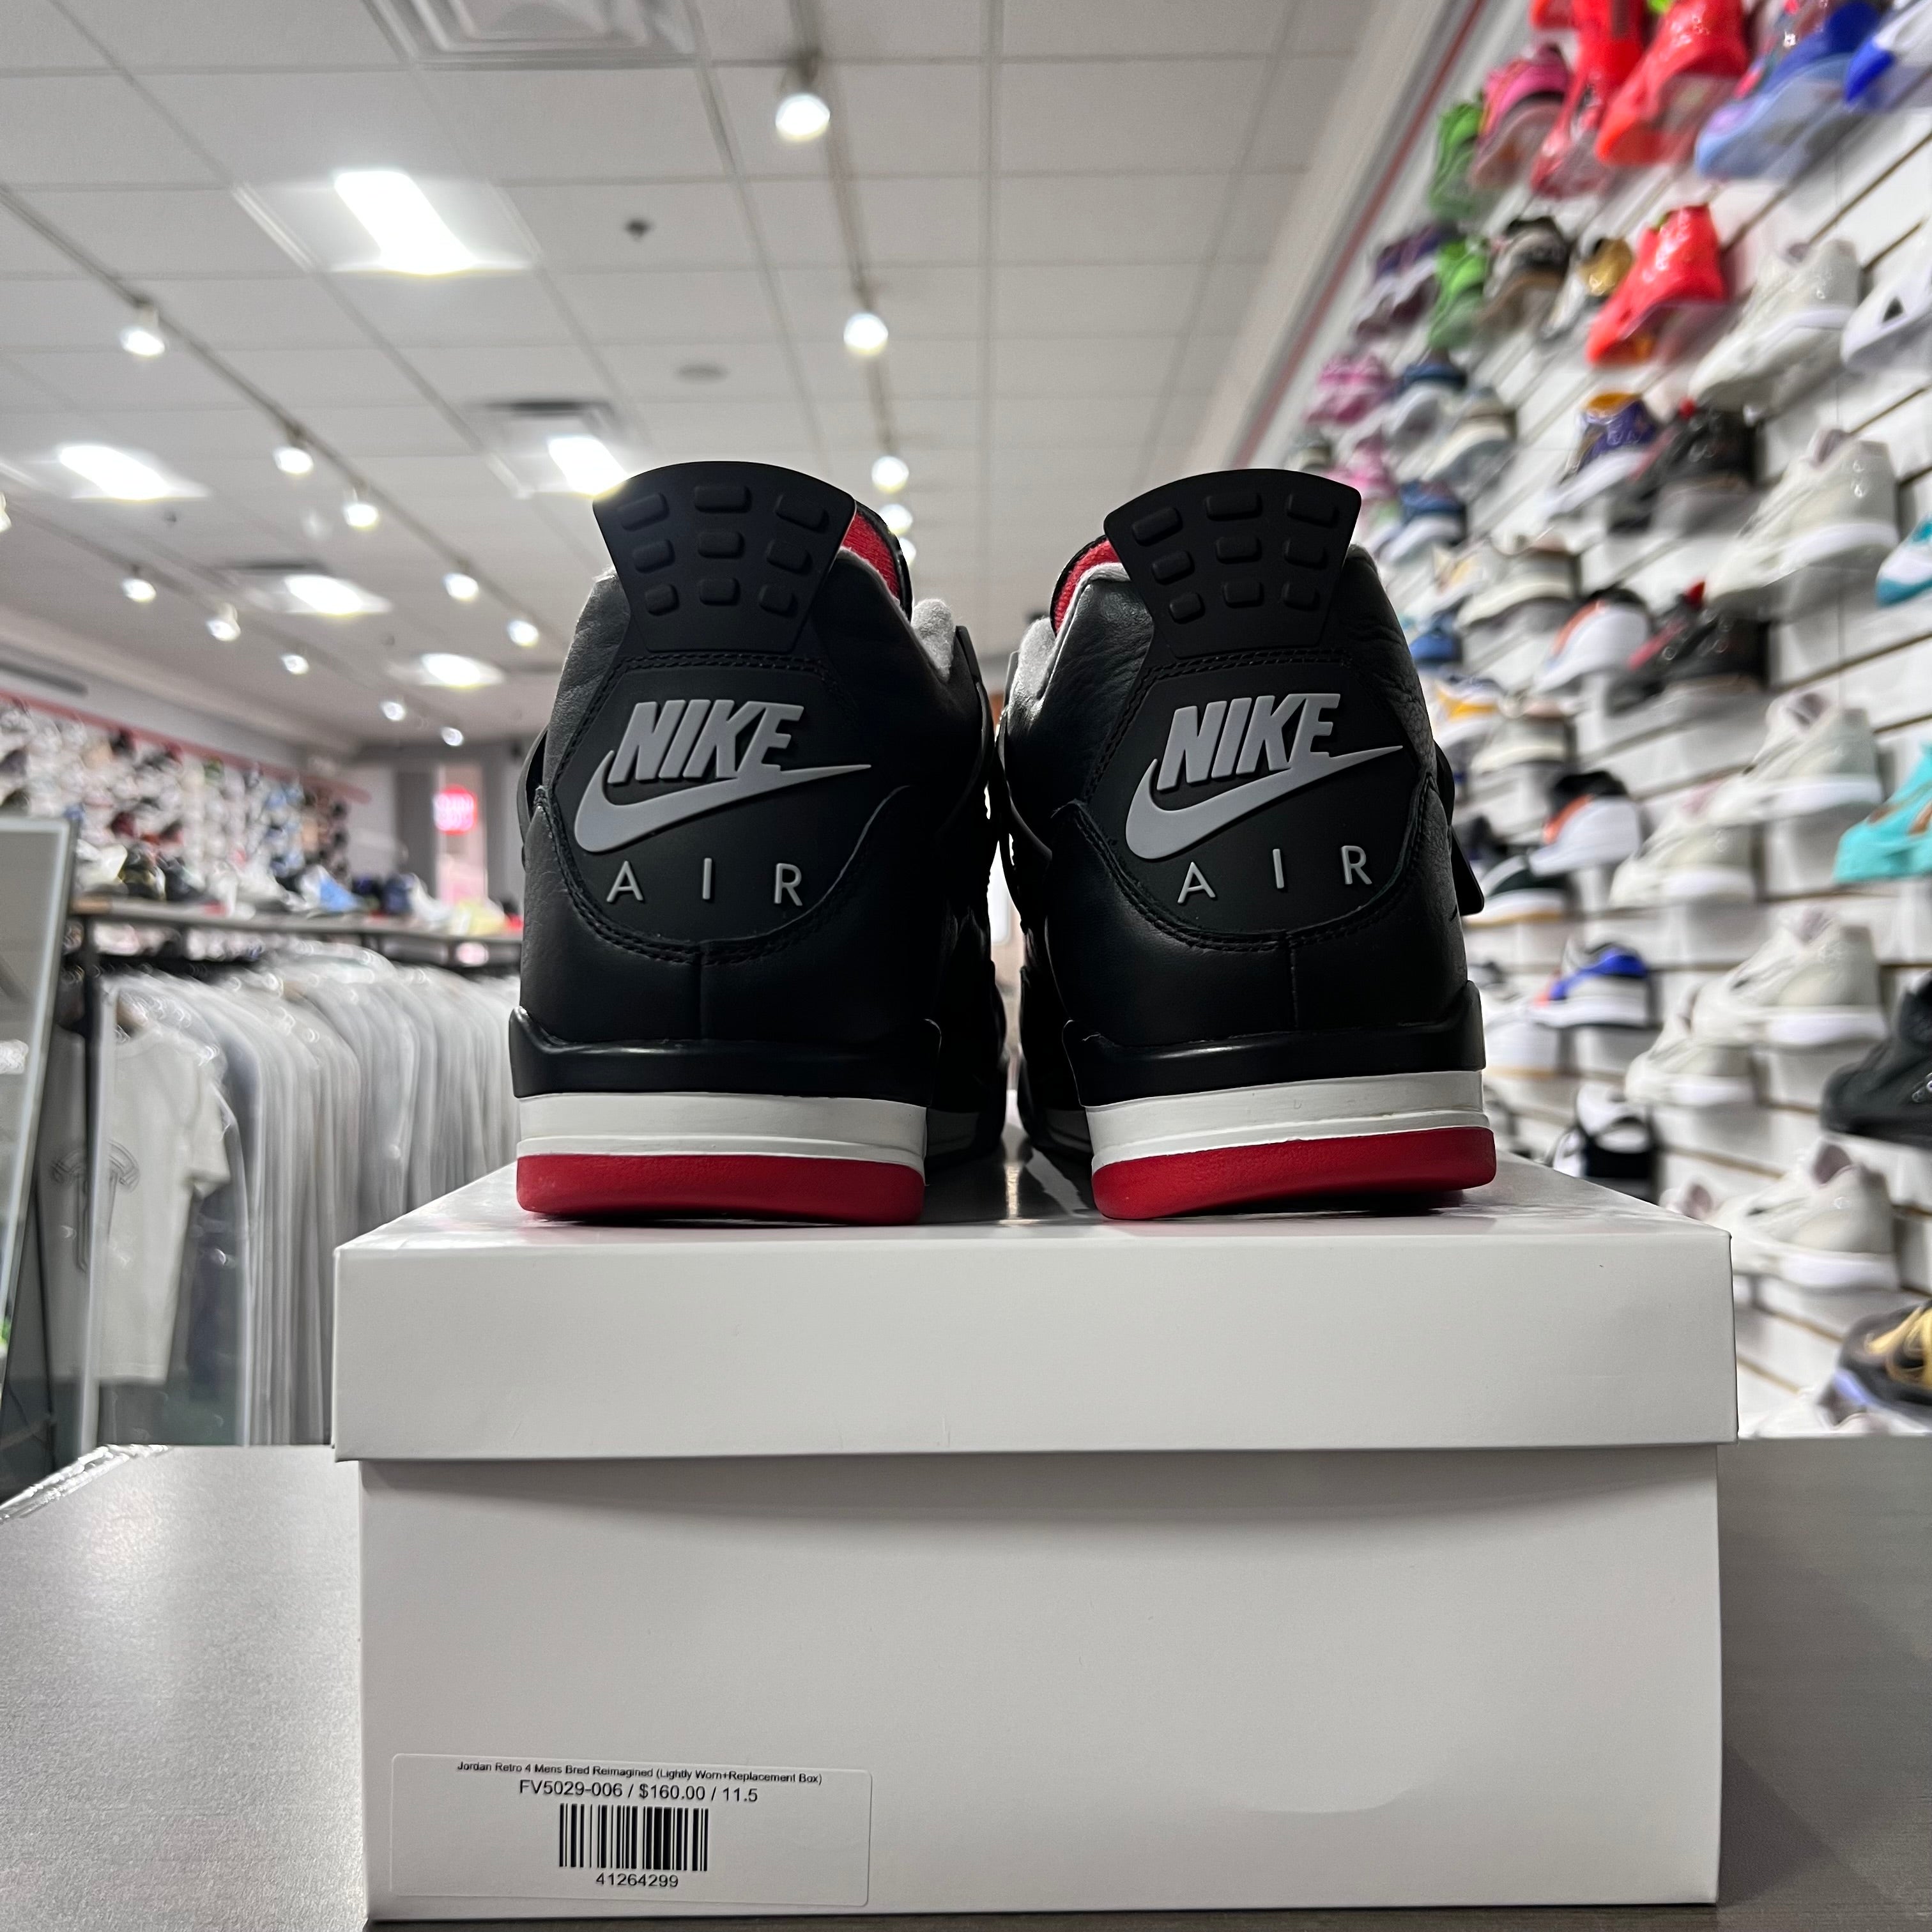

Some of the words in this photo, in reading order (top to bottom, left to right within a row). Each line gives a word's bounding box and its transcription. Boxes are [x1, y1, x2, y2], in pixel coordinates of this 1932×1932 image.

[608, 700, 804, 784] NIKE
[1156, 693, 1340, 790] NIKE
[607, 857, 803, 906] AIR
[1177, 845, 1372, 903] AIR
[457, 1761, 491, 1771] Jordan
[495, 1762, 522, 1772] Retro
[525, 1763, 531, 1772] 4
[535, 1763, 562, 1774] Mens
[565, 1765, 589, 1774] Bred
[593, 1766, 653, 1778] Reimagined
[656, 1768, 693, 1781] (Lightly
[695, 1770, 796, 1782] Worn+Replacement
[799, 1773, 822, 1785] Box)
[519, 1779, 622, 1797] FV5029-006
[627, 1783, 634, 1798] /
[639, 1783, 705, 1800] $160.00
[710, 1786, 717, 1801] /
[723, 1787, 758, 1802] 11.5
[595, 1872, 678, 1887] 41264299
